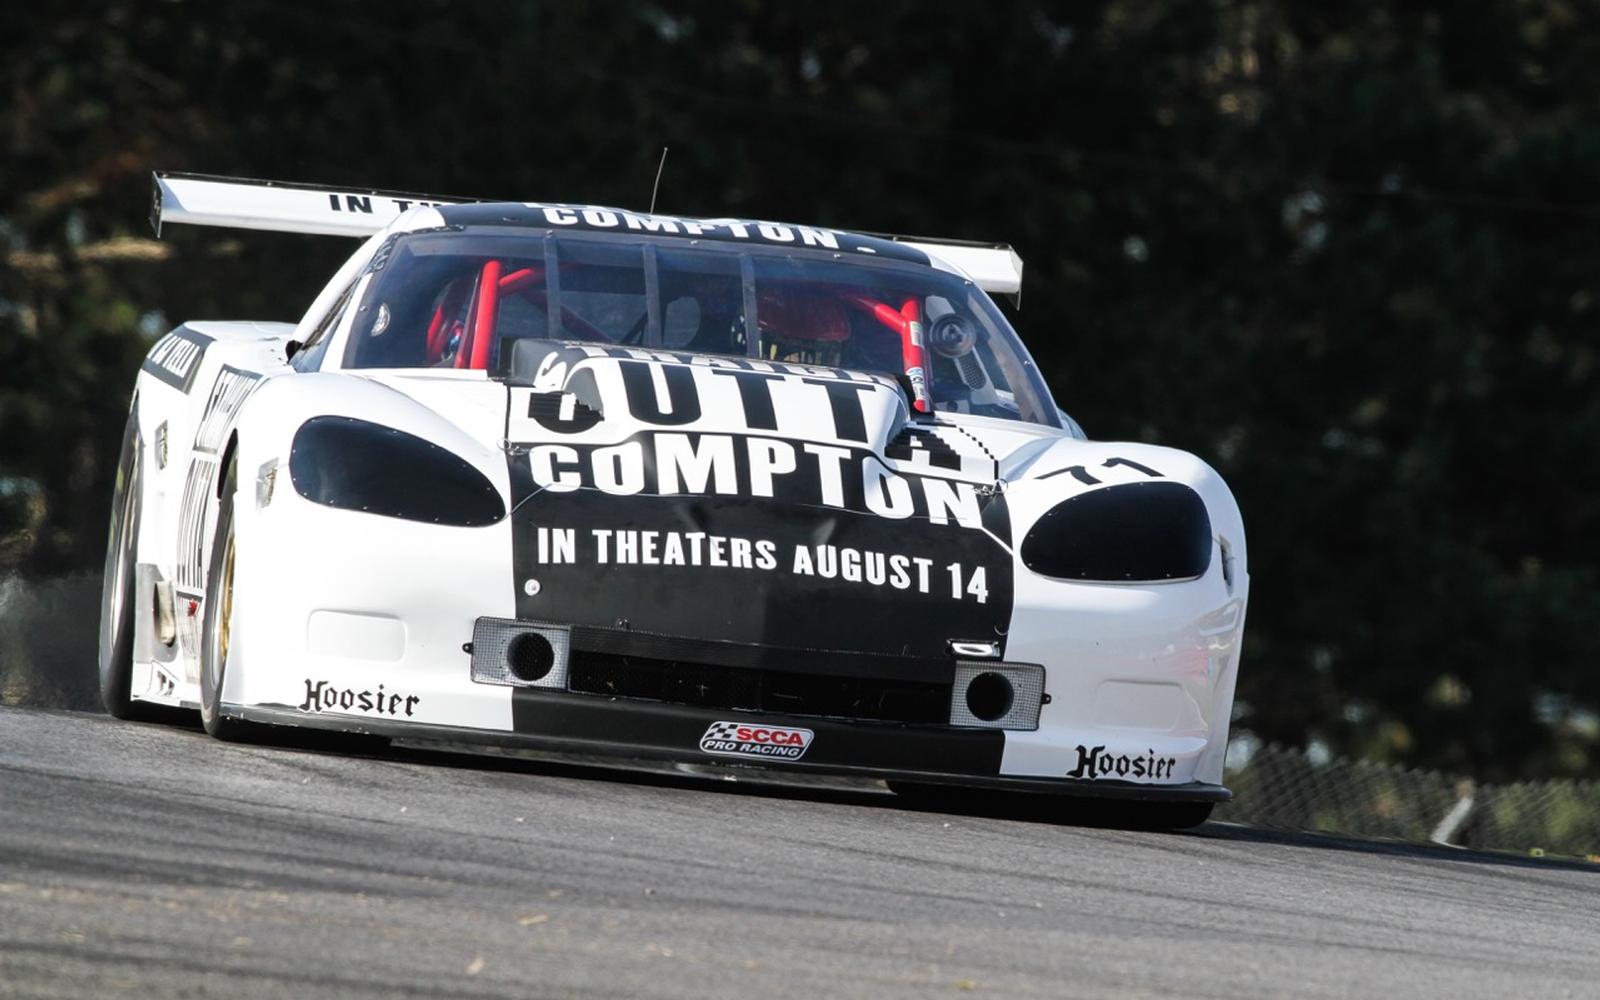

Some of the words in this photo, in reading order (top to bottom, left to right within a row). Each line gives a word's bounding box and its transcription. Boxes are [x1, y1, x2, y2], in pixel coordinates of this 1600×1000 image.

[329, 194, 373, 214] IN
[541, 206, 840, 249] COMPTON
[528, 359, 962, 472] OUTTA
[529, 432, 984, 529] COMPTON
[537, 527, 576, 564] IN
[592, 529, 777, 570] THEATERS
[793, 544, 933, 594] AUGUST
[947, 562, 989, 604] 14
[298, 678, 420, 717] Hoosier
[703, 740, 736, 751] PRO
[739, 742, 800, 757] RACING
[736, 727, 804, 747] SCCA
[1066, 744, 1176, 779] Hoosier
